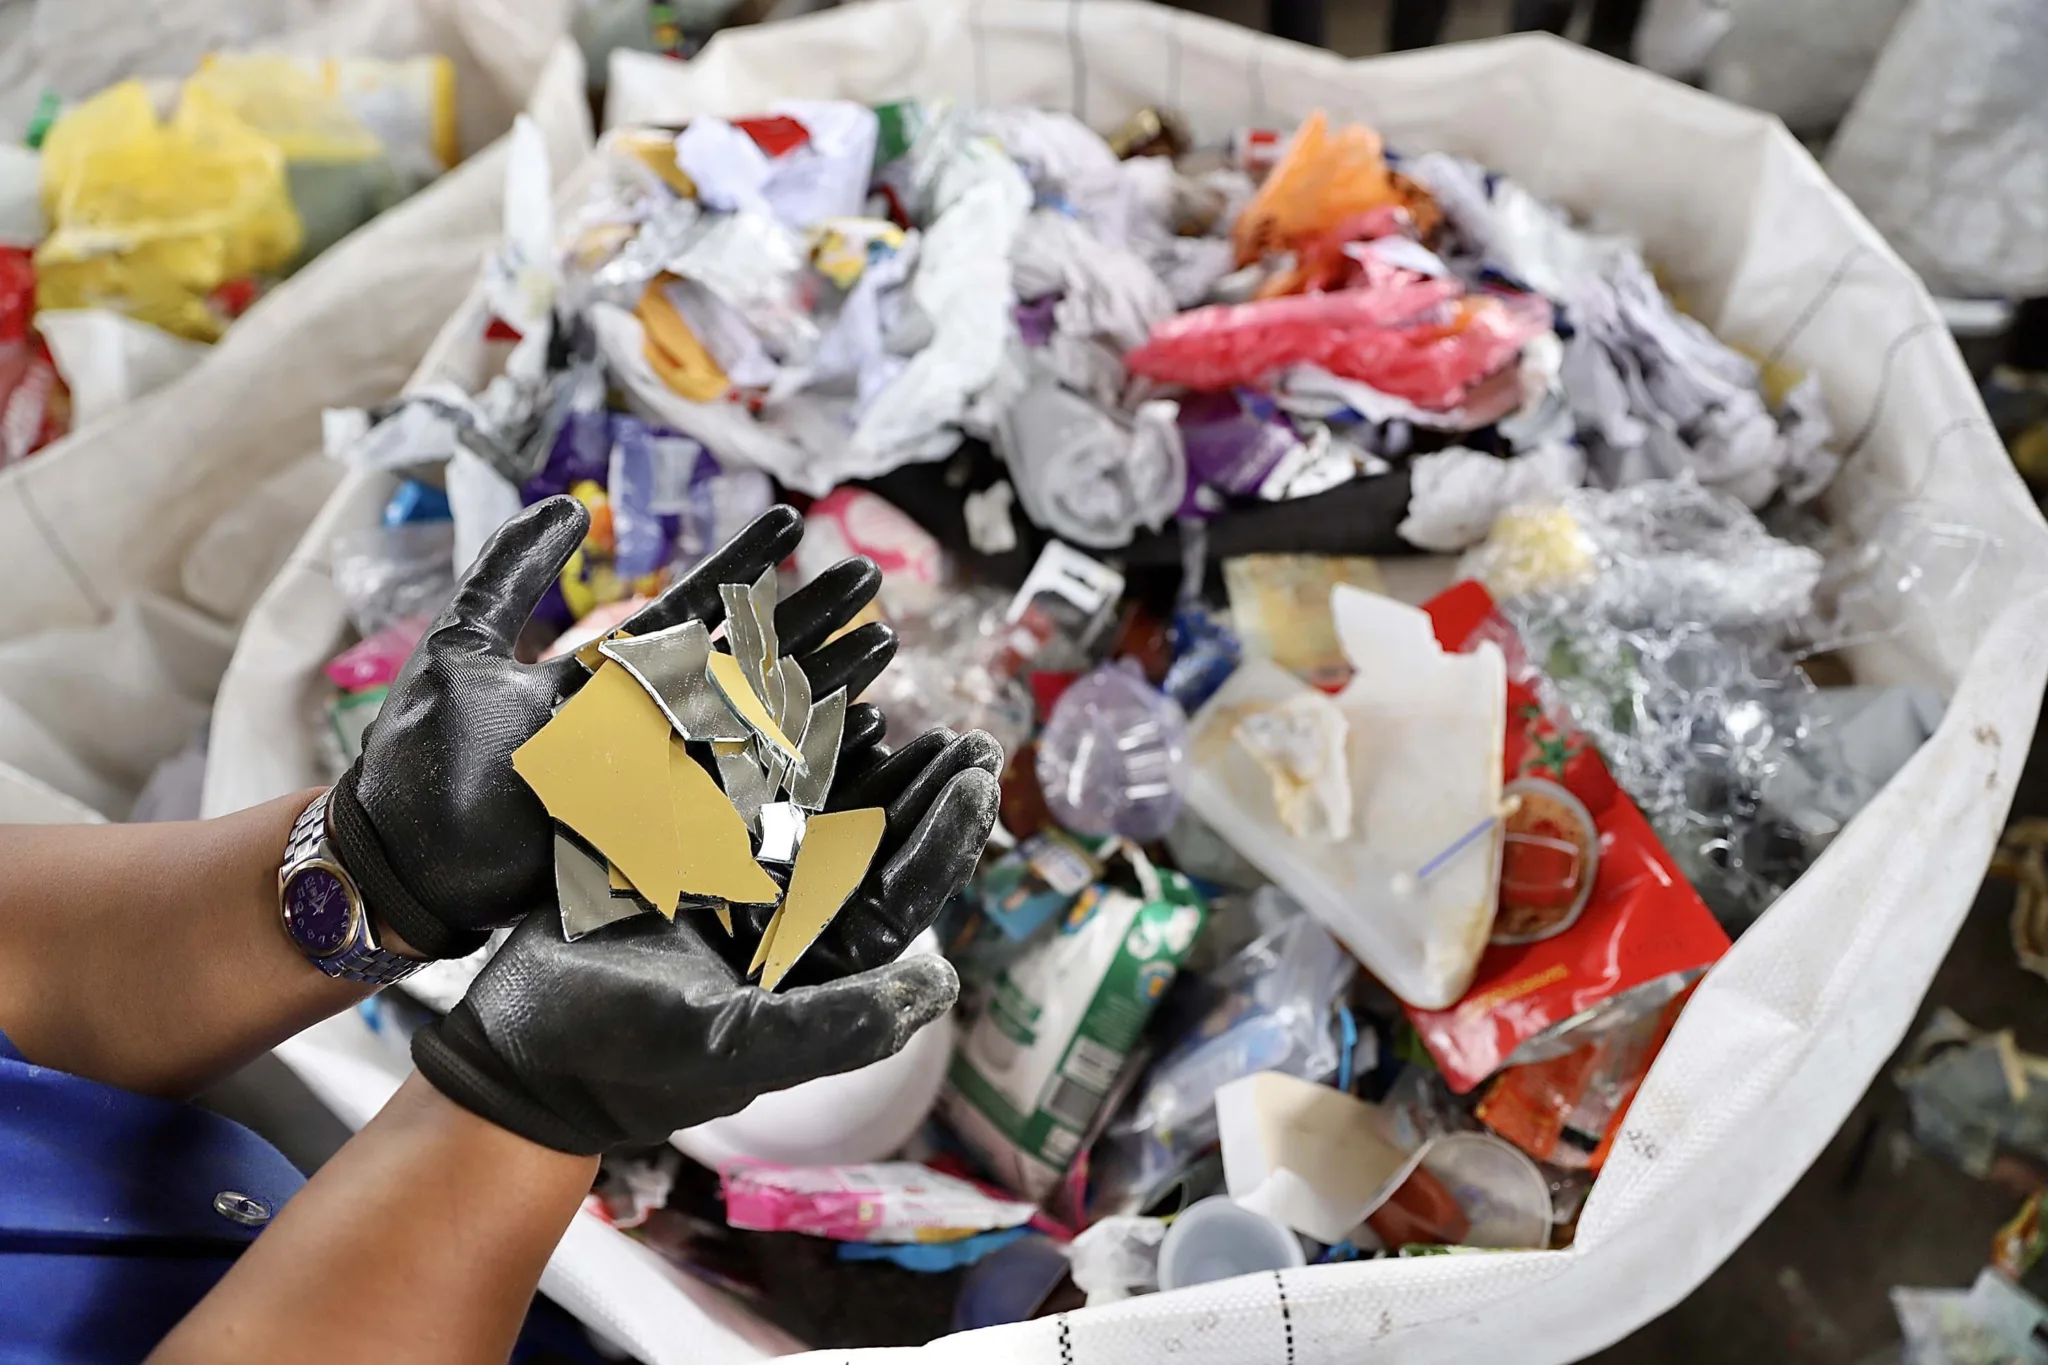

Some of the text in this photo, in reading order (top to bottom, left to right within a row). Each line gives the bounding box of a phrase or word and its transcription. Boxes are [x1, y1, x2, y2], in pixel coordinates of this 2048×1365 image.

[304, 876, 315, 889] 12
[296, 886, 306, 898] 11
[294, 901, 304, 915] 10
[297, 917, 305, 929] 9
[306, 928, 315, 940] 8
[331, 931, 339, 942] 6
